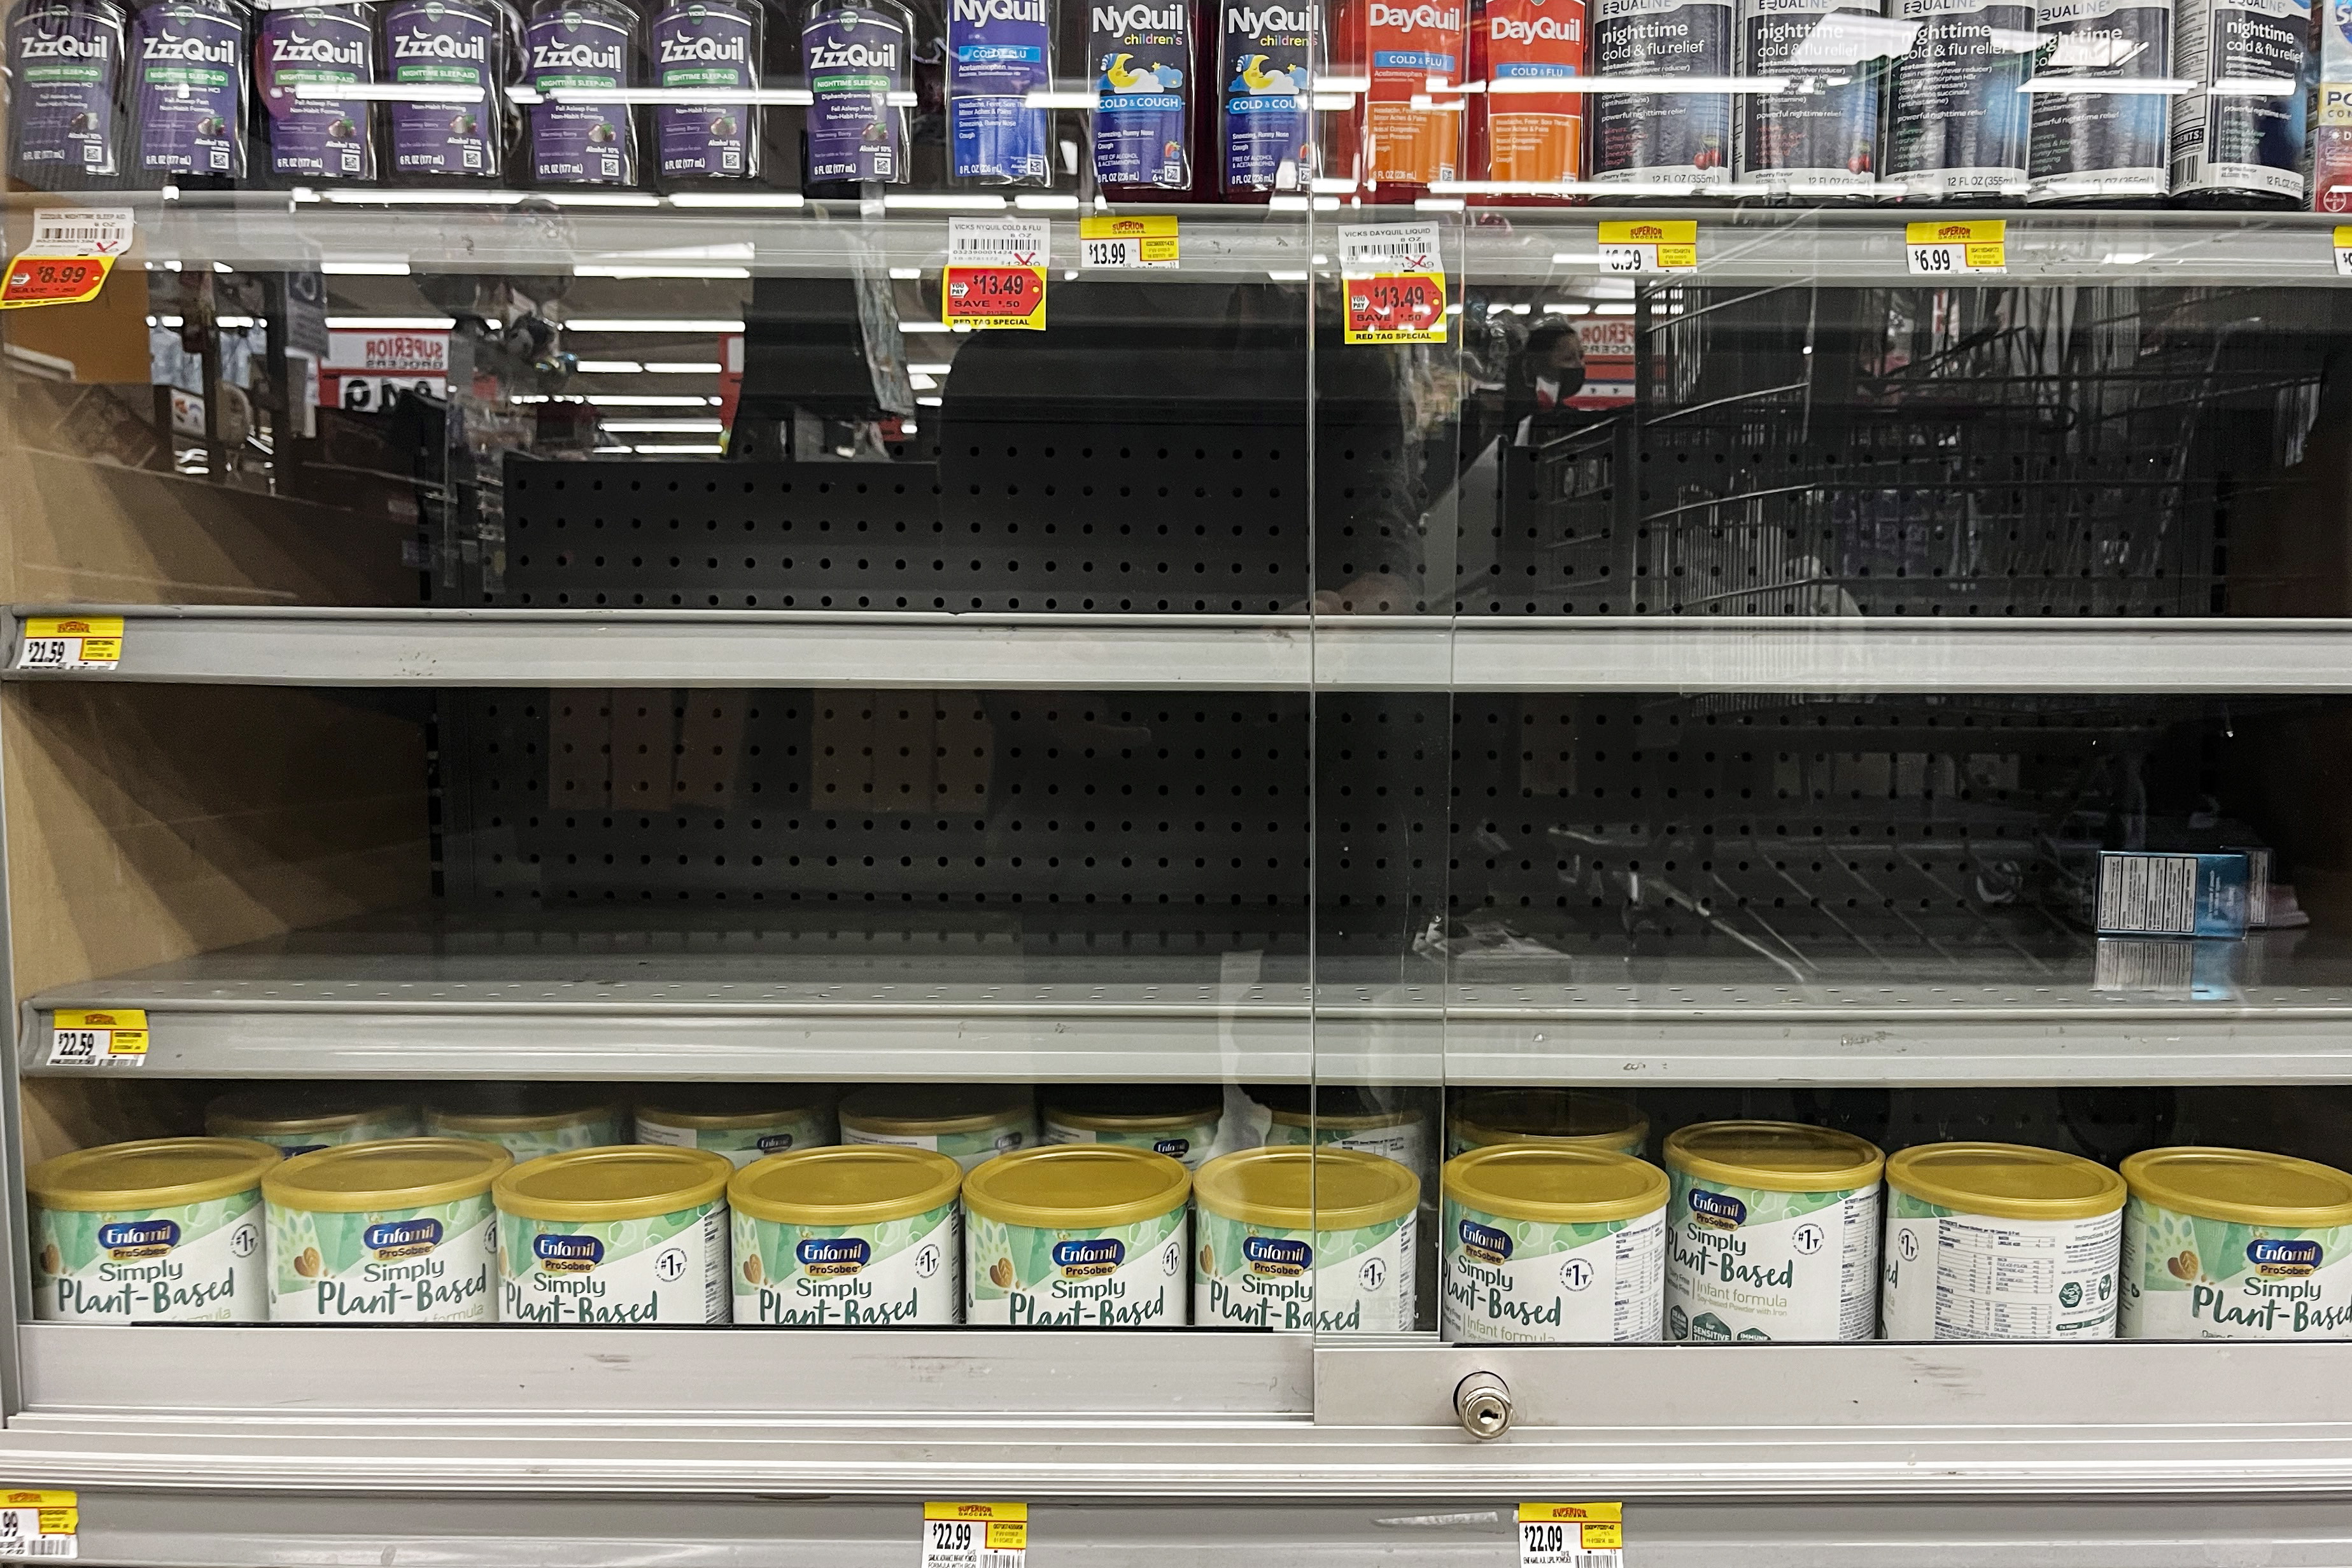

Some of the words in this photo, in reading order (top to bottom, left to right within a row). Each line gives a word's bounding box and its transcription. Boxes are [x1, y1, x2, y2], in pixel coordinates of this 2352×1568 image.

[954, 0, 1046, 27] NyQuil
[1093, 4, 1183, 38] NyQuil
[1228, 5, 1319, 39] NyQuil
[1370, 4, 1460, 33] DayQuil
[1124, 34, 1183, 46] children's
[1492, 17, 1580, 45] DayQuil
[1602, 22, 1689, 45] nighttime
[1757, 22, 1843, 43] nighttime
[2227, 19, 2294, 45] nighttime
[21, 36, 107, 59] ZzzQuil
[143, 38, 234, 63] ZzzQuil
[272, 39, 363, 66] ZzzQuil
[395, 34, 484, 62] ZzzQuil
[533, 45, 621, 71] ZzzQuil
[661, 37, 744, 64] ZzzQuil
[810, 44, 895, 69] ZzzQuil
[1602, 45, 1631, 60] cold
[1633, 45, 1645, 57] &
[1647, 42, 1665, 55] flu
[1668, 39, 1705, 54] relief
[1757, 44, 1788, 57] cold
[1901, 45, 1931, 61] cold
[1934, 45, 1945, 57] &
[1948, 43, 1967, 56] flu
[2227, 40, 2253, 53] cold
[2255, 42, 2264, 53] &
[2265, 43, 2278, 58] flu
[2280, 48, 2304, 64] relief
[1390, 55, 1416, 64] COLD
[1425, 57, 1442, 66] FLU
[1511, 67, 1537, 76] COLD
[1546, 68, 1563, 76] FLU
[578, 80, 612, 88] SLEEP-AID
[668, 73, 701, 81] NIGHTTIME
[701, 73, 735, 81] SLEEP-AID
[1099, 99, 1127, 109] COLD
[1138, 97, 1178, 108] COUGH
[1233, 101, 1262, 110] COLD
[1602, 111, 1631, 122] powerful
[1757, 111, 1788, 120] powerful
[1663, 175, 1673, 183] FL
[1674, 175, 1686, 183] OZ
[1948, 178, 1957, 186] 12
[1959, 177, 1969, 186] FL
[1971, 176, 1983, 185] OZ
[1112, 221, 1144, 231] SUPERIOR
[1630, 226, 1662, 235] SUPERIOR
[1938, 226, 1971, 235] SUPERIOR
[1089, 242, 1125, 264] $13.99
[1915, 249, 1950, 270] $6.99
[38, 266, 87, 283] $8.99
[973, 275, 1024, 295] $13.49
[1374, 286, 1424, 308] $13.49
[29, 641, 65, 662] $21.59
[59, 1032, 94, 1055] $22.59
[1693, 1194, 1739, 1218] Enfamil
[106, 1227, 171, 1245] Enfamil
[372, 1223, 435, 1245] Enfamil
[1463, 1224, 1506, 1251] Enfamil
[1687, 1222, 1747, 1256] Simply
[1798, 1229, 1812, 1250] #1
[540, 1239, 595, 1257] Enfamil
[804, 1243, 863, 1260] Enfamil
[1060, 1245, 1118, 1261] Enfamil
[1250, 1242, 1305, 1262] Enfamil
[1466, 1245, 1503, 1264] ProSobee
[1668, 1226, 1793, 1289] Plant-Based
[2257, 1245, 2316, 1261] Enfamil
[99, 1259, 183, 1283] Simply
[363, 1257, 444, 1282] Simply
[661, 1254, 674, 1277] #1
[809, 1265, 860, 1274] ProSobee
[1066, 1266, 1115, 1275] ProSobee
[1254, 1263, 1302, 1275] ProSobee
[1458, 1255, 1514, 1291] Simply
[1566, 1264, 1579, 1286] #1
[58, 1267, 234, 1315] Plant-Based
[318, 1263, 487, 1315] Plant-Based
[533, 1272, 605, 1298] Simply
[796, 1277, 872, 1300] Simply
[1052, 1278, 1125, 1301] Simply
[1242, 1273, 1313, 1301] Simply
[1444, 1257, 1561, 1327] Plant-Based
[1697, 1279, 1729, 1300] Infant
[1733, 1289, 1787, 1308] formula
[2244, 1277, 2321, 1301] Simply
[506, 1280, 658, 1323] Plant-Based
[760, 1287, 918, 1325] Plant-Based
[1010, 1285, 1164, 1326] Plant-Based
[1211, 1279, 1360, 1330] Plant-Based
[1467, 1315, 1498, 1337] Infant
[1501, 1326, 1556, 1342] formula
[1693, 1326, 1730, 1340] SENSITIVE
[933, 1522, 971, 1550] $22.99
[1525, 1525, 1563, 1552] $22.09
